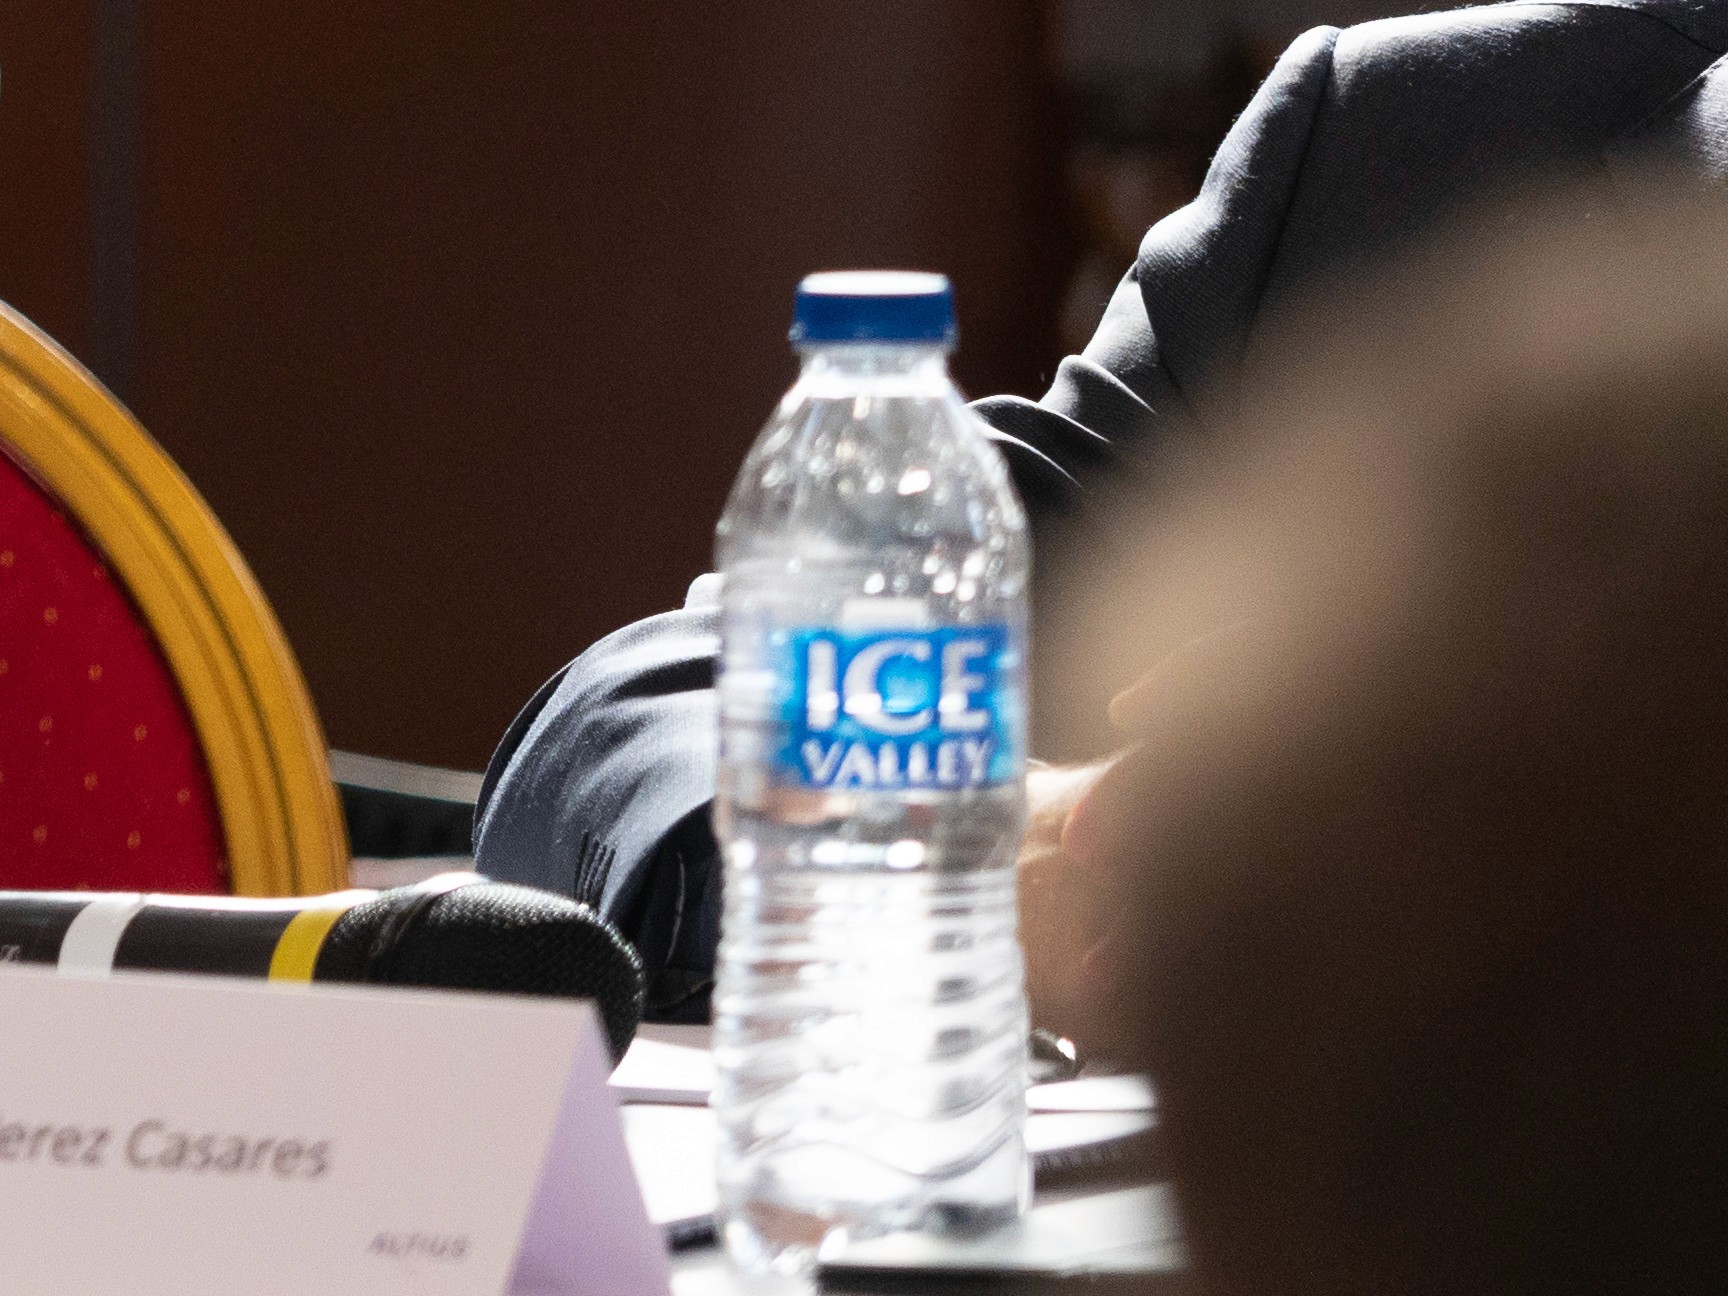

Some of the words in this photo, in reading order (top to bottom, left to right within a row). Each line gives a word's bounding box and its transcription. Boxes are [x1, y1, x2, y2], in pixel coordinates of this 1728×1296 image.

[805, 638, 991, 735] ICE
[801, 739, 992, 788] VALLEY
[125, 1119, 332, 1179] Casares
[366, 1230, 470, 1259] ALTIUS
